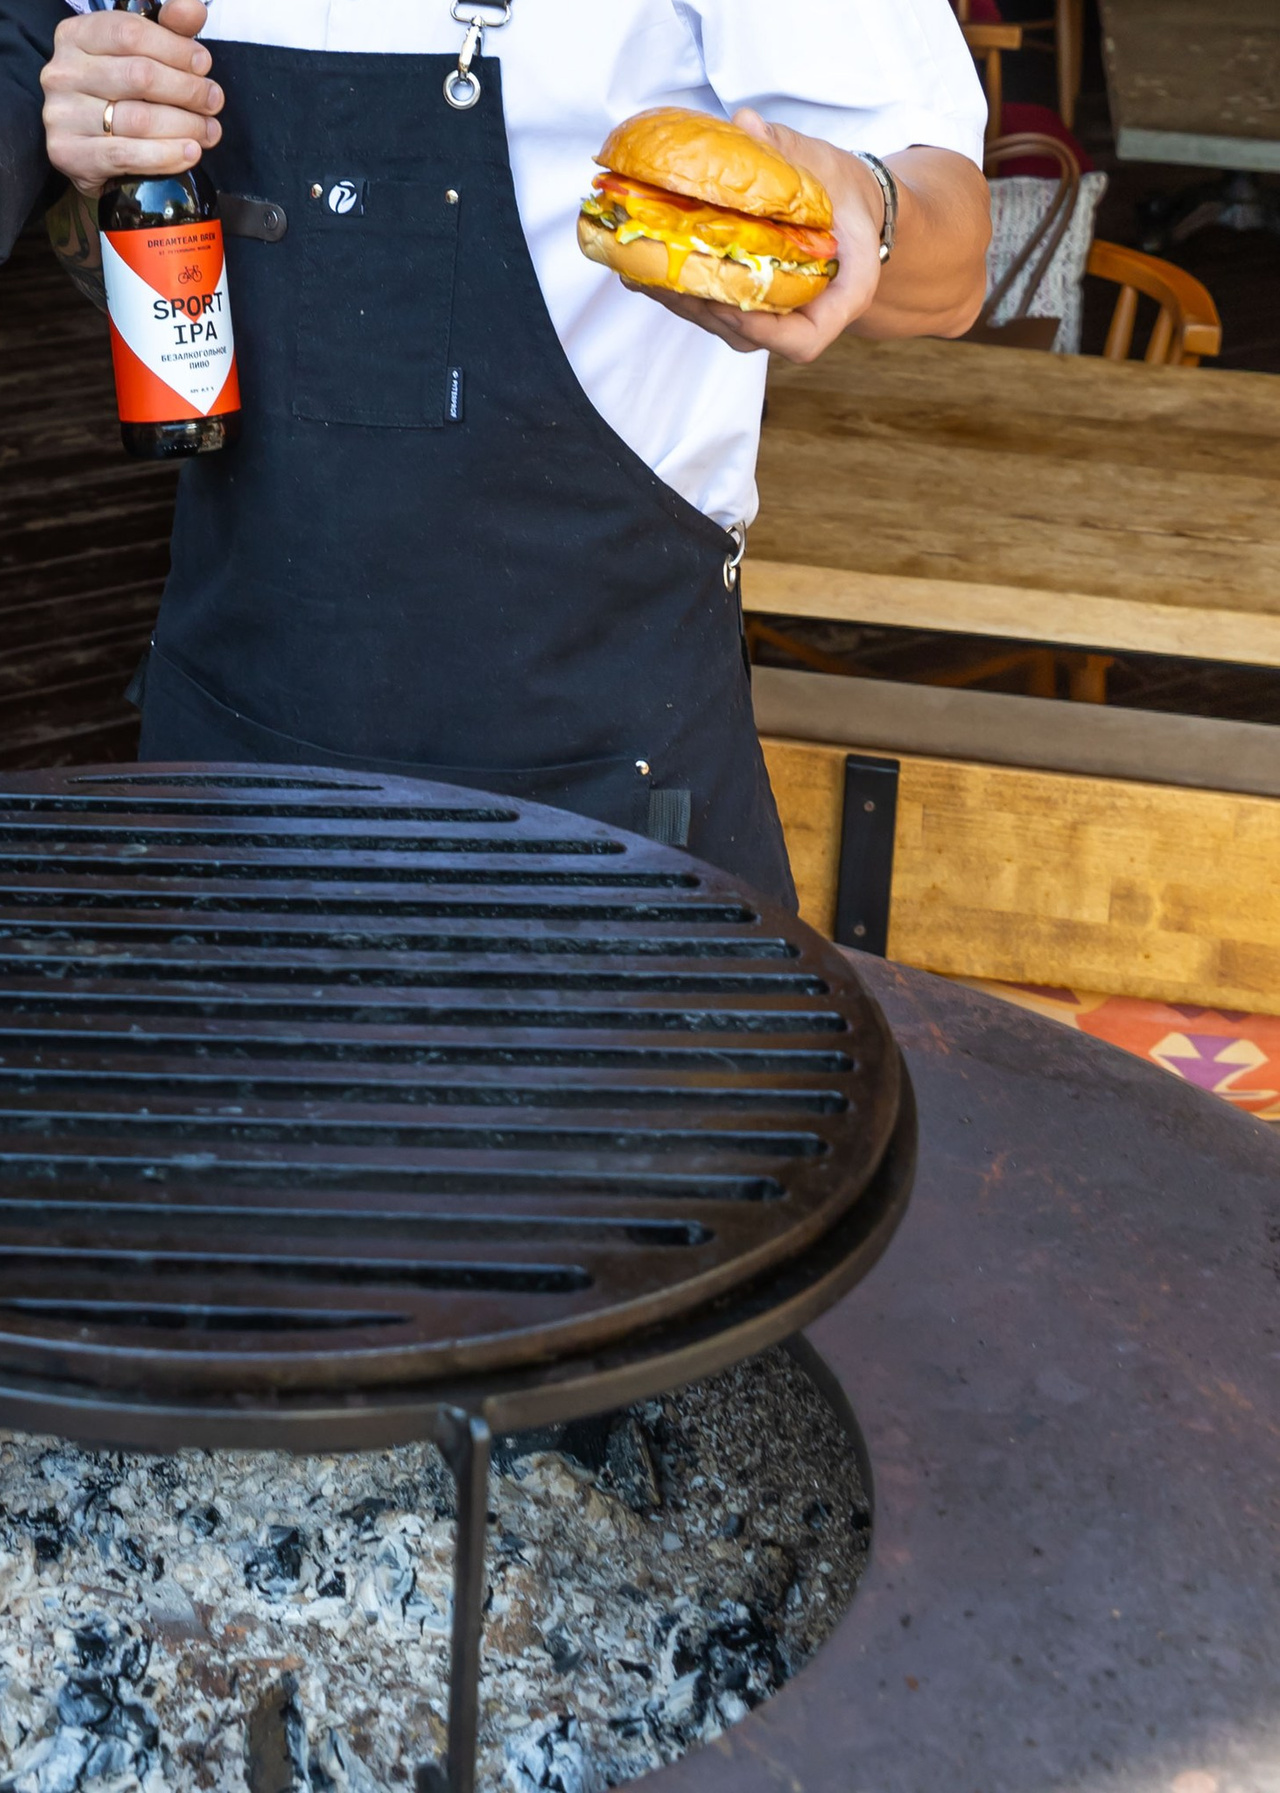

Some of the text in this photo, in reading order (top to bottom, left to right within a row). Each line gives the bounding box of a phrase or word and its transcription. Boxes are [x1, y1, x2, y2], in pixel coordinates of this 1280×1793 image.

[147, 235, 198, 248] DREAMTEAM
[153, 291, 223, 320] SPORT
[173, 320, 218, 345] IPA
[189, 360, 210, 370] ПИВО
